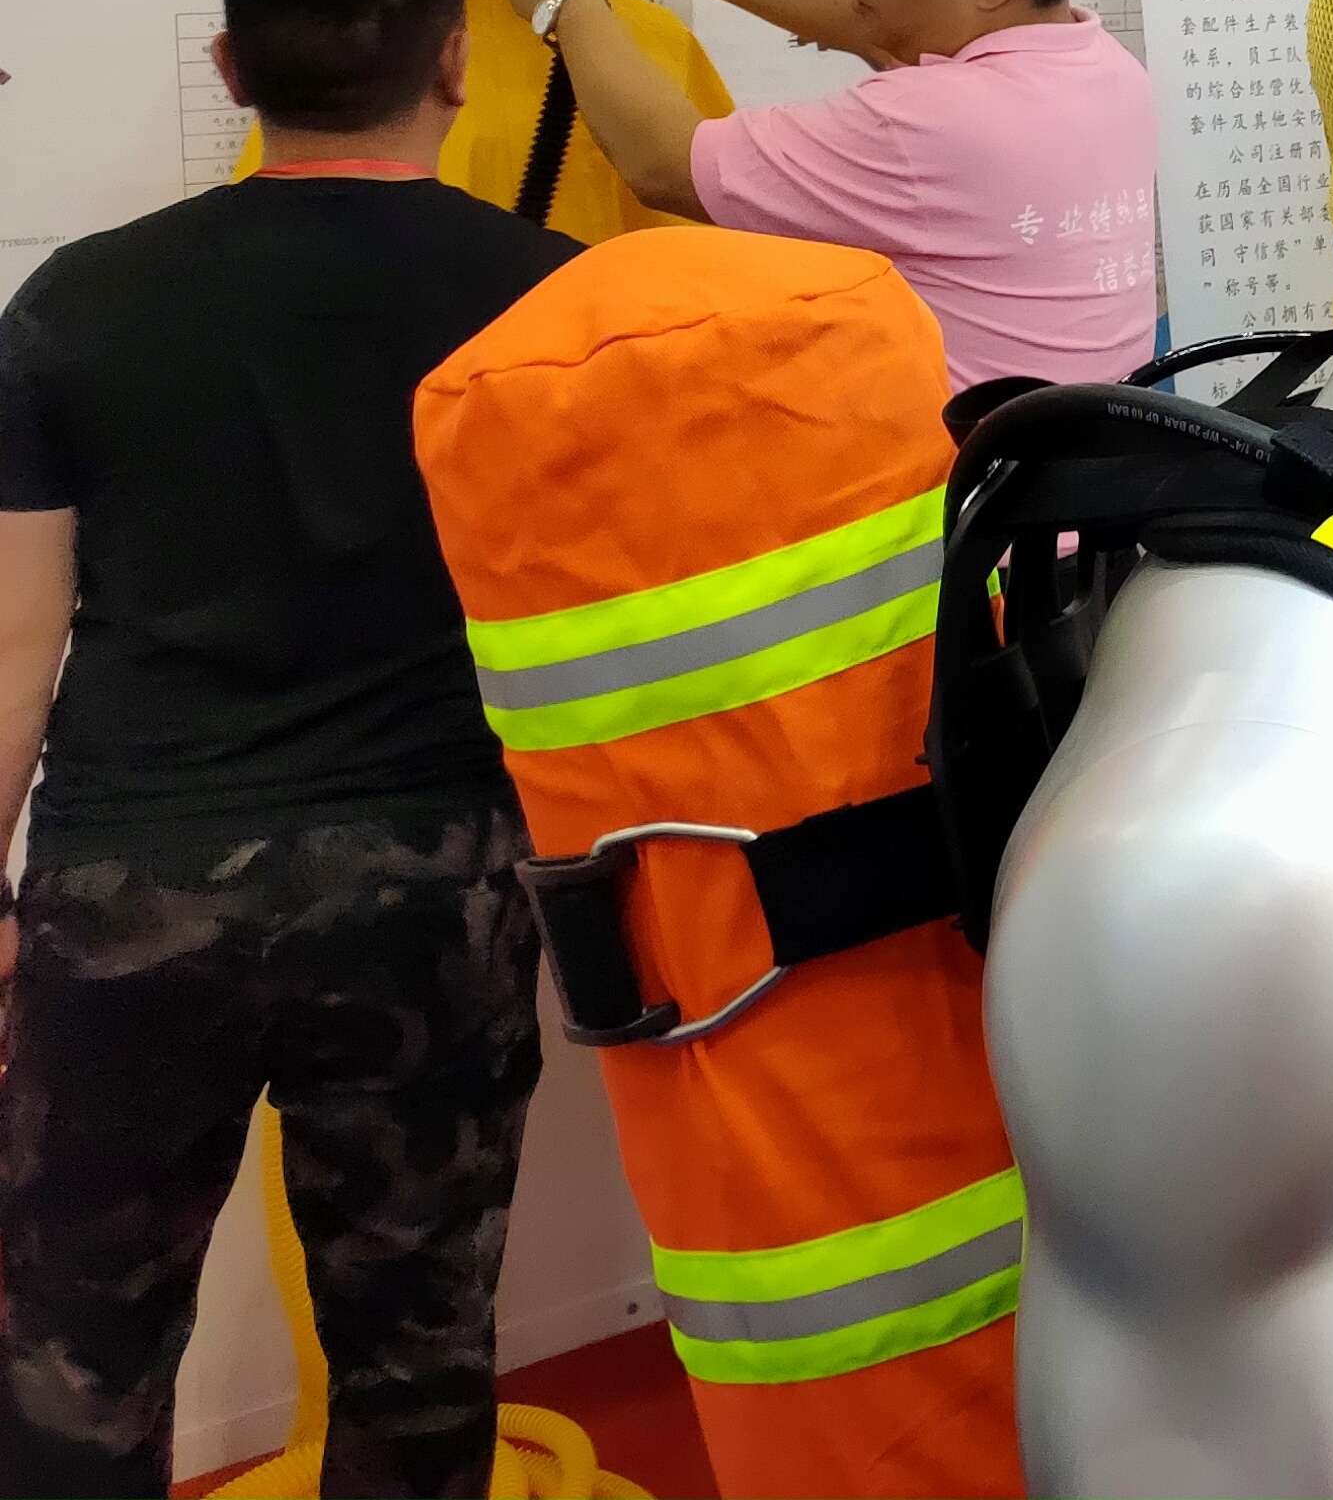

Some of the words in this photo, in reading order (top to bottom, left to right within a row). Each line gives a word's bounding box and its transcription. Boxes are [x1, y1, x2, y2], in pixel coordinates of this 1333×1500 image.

[1180, 14, 1313, 36] 套配件生产装
[1164, 415, 1187, 433] BAR
[1202, 429, 1220, 443] WP
